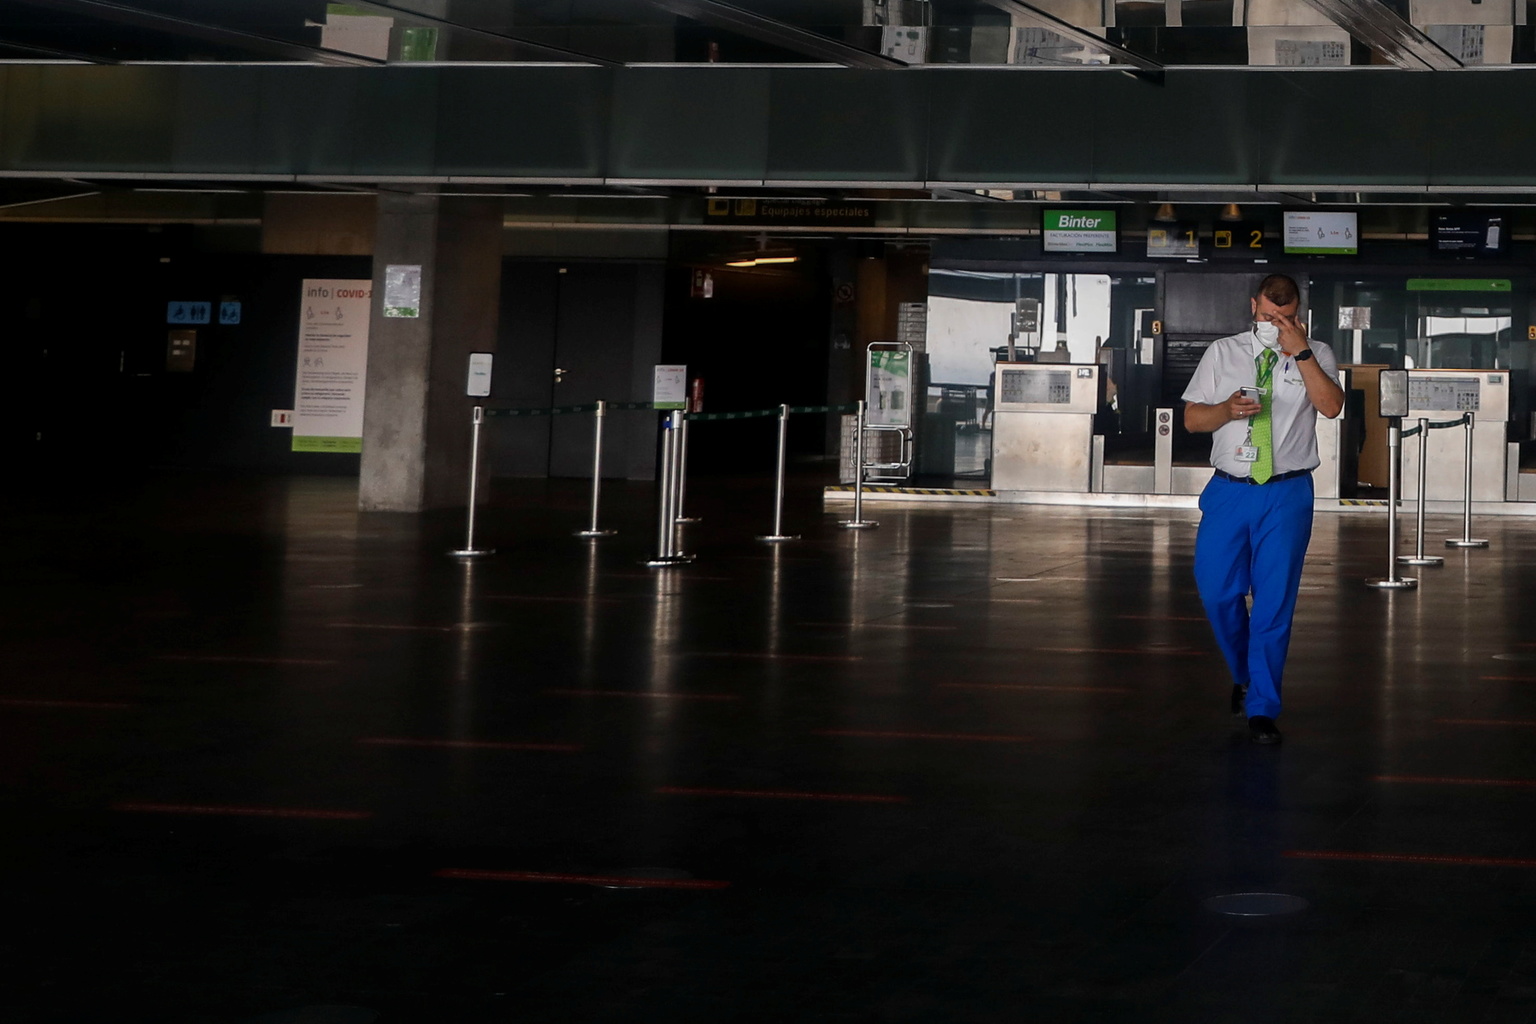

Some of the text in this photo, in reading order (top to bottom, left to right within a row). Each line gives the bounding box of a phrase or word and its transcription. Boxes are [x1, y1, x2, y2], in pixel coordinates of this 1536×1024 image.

[761, 205, 870, 217] Equipajes especiales
[1058, 215, 1101, 228] Binter
[1185, 230, 1197, 248] 1
[1250, 230, 1262, 248] 2
[307, 286, 329, 298] info
